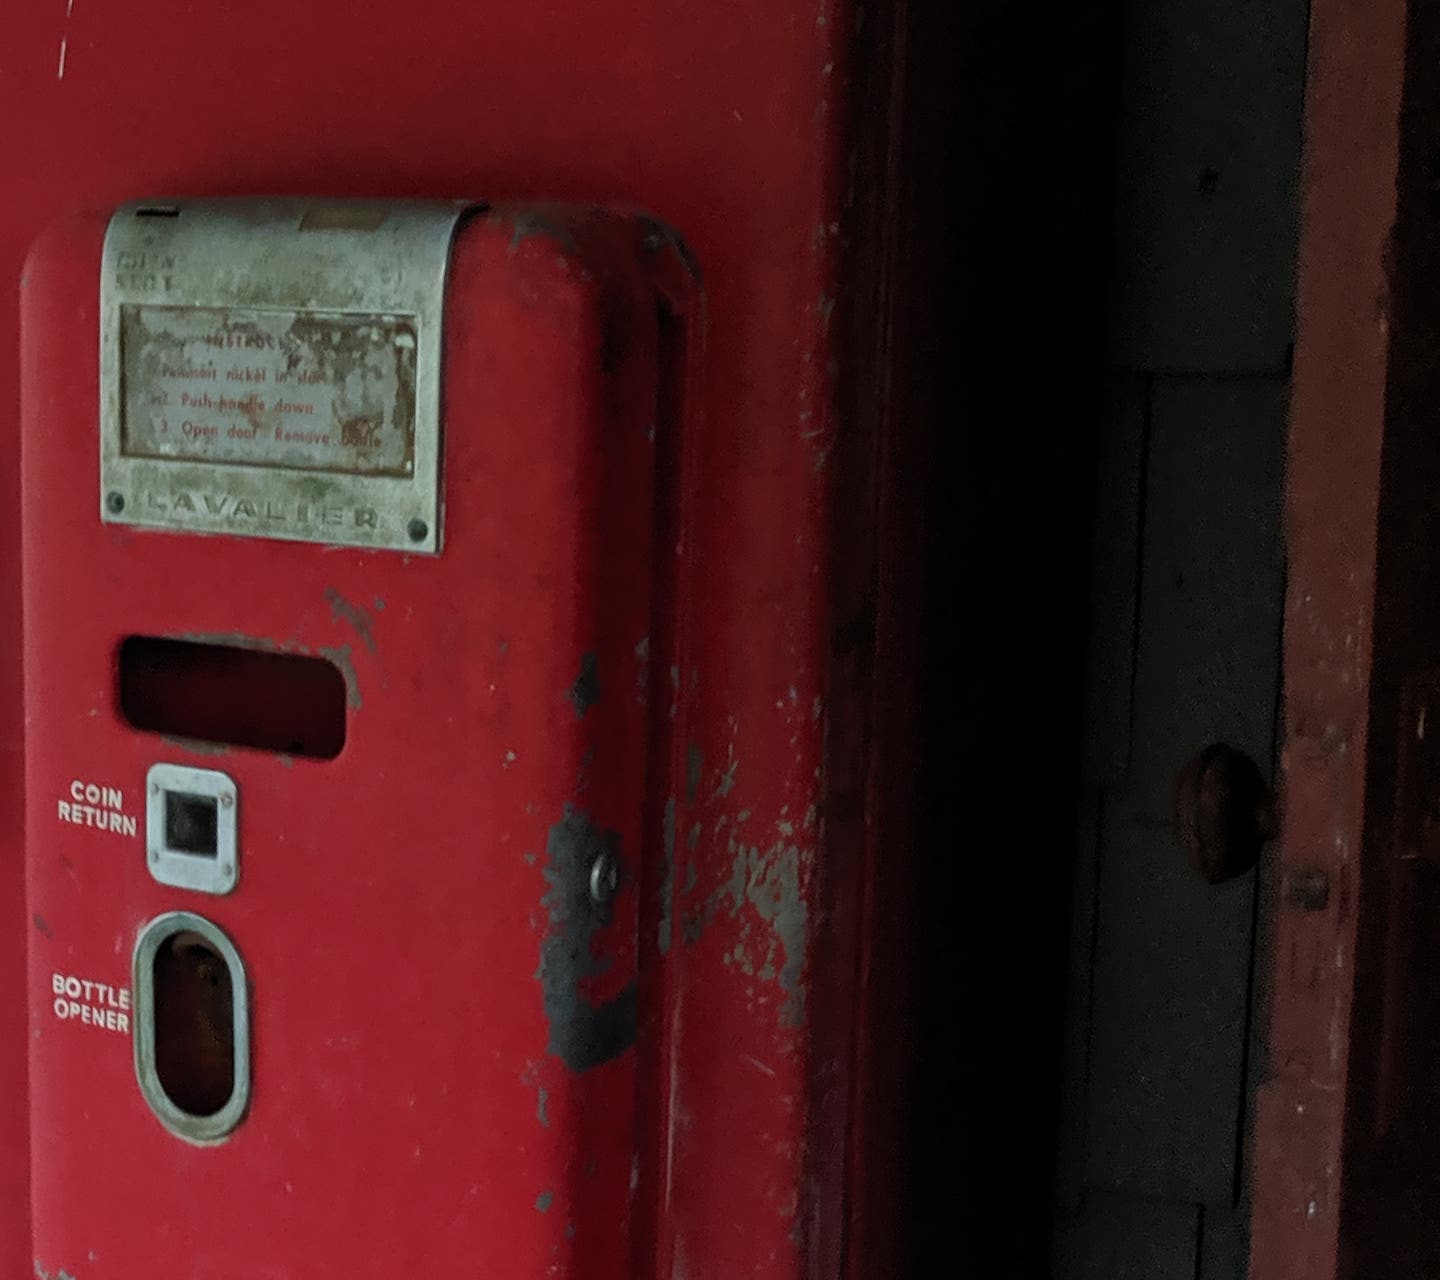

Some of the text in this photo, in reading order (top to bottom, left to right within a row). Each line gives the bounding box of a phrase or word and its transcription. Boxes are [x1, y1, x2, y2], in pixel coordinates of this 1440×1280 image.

[181, 392, 212, 408] Push
[274, 398, 314, 415] down
[181, 420, 219, 439] Open
[70, 780, 122, 811] COIN
[58, 800, 136, 837] RETURN
[53, 973, 130, 1009] BOTTLE
[54, 998, 129, 1034] OPENER
